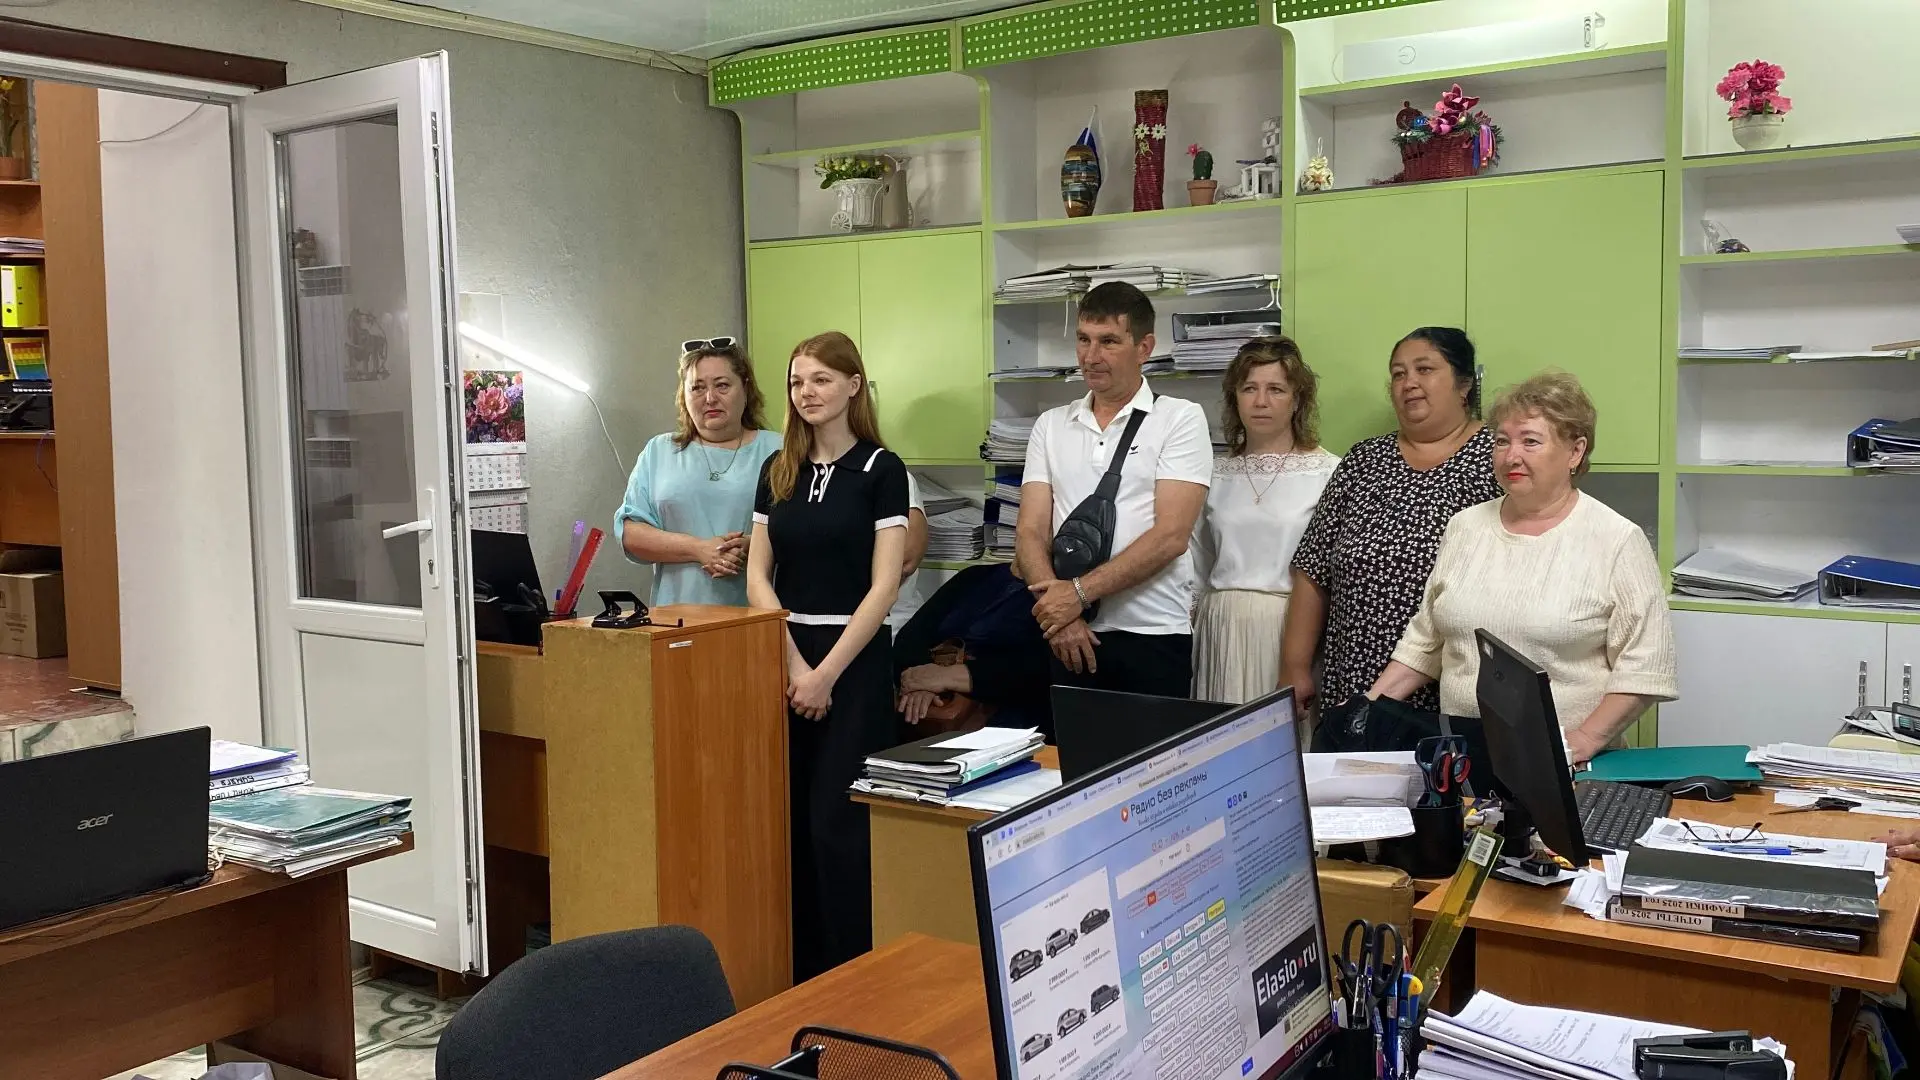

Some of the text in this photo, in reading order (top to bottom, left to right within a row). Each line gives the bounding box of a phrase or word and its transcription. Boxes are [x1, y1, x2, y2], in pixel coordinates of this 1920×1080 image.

[1130, 797, 1155, 816] Радио
[1157, 788, 1172, 803] без
[1174, 772, 1207, 797] рекламы
[77, 813, 114, 831] acer
[1644, 897, 1739, 915] ГРАФИКИ 2025 год
[1613, 906, 1702, 926] ОТЧЕТЫ 2025 год
